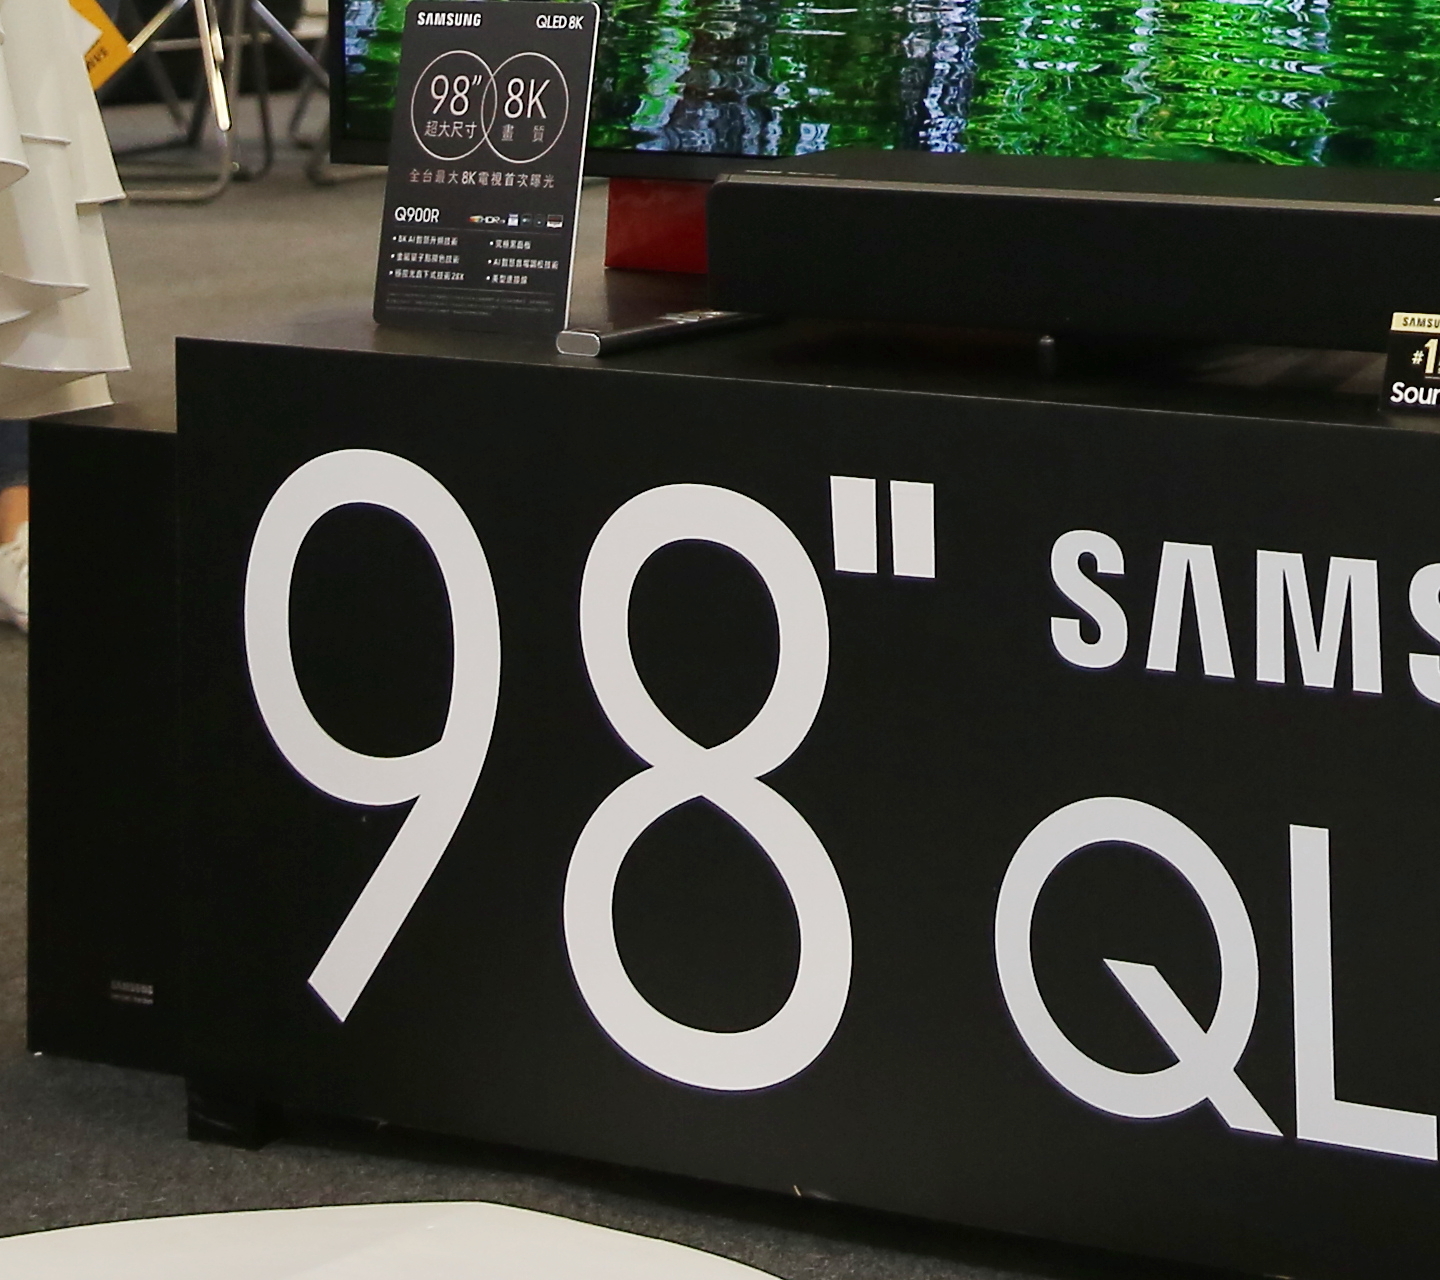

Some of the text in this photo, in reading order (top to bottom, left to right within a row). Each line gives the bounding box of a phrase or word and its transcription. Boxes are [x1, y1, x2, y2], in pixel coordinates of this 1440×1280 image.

[417, 11, 482, 27] SAMSUNG
[536, 15, 585, 30] QLED 8K
[504, 77, 551, 119] 8K
[424, 120, 477, 139] 超大尺寸
[394, 206, 440, 223] Q900R
[244, 448, 936, 1092] 98"
